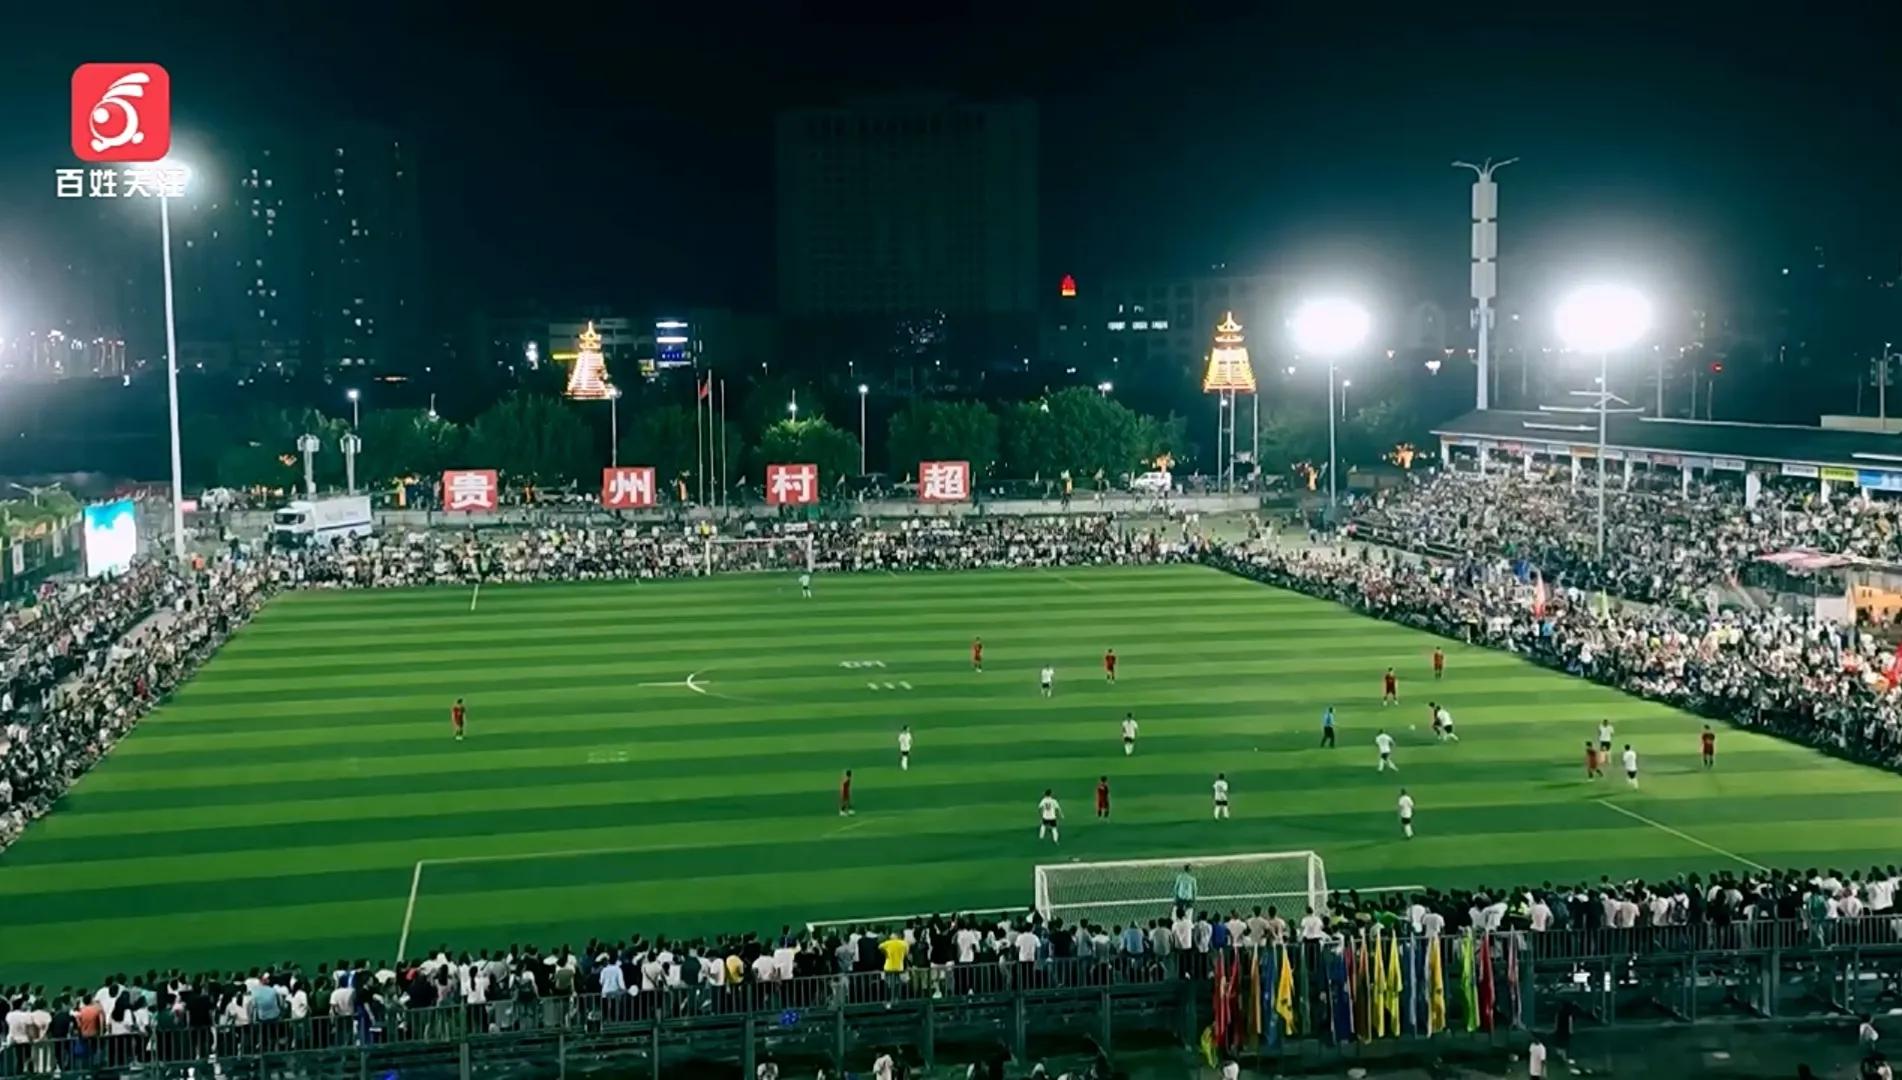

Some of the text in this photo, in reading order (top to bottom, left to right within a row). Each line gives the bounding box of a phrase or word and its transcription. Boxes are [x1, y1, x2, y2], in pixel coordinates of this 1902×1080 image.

[448, 463, 967, 510] 贵 州 村 超
